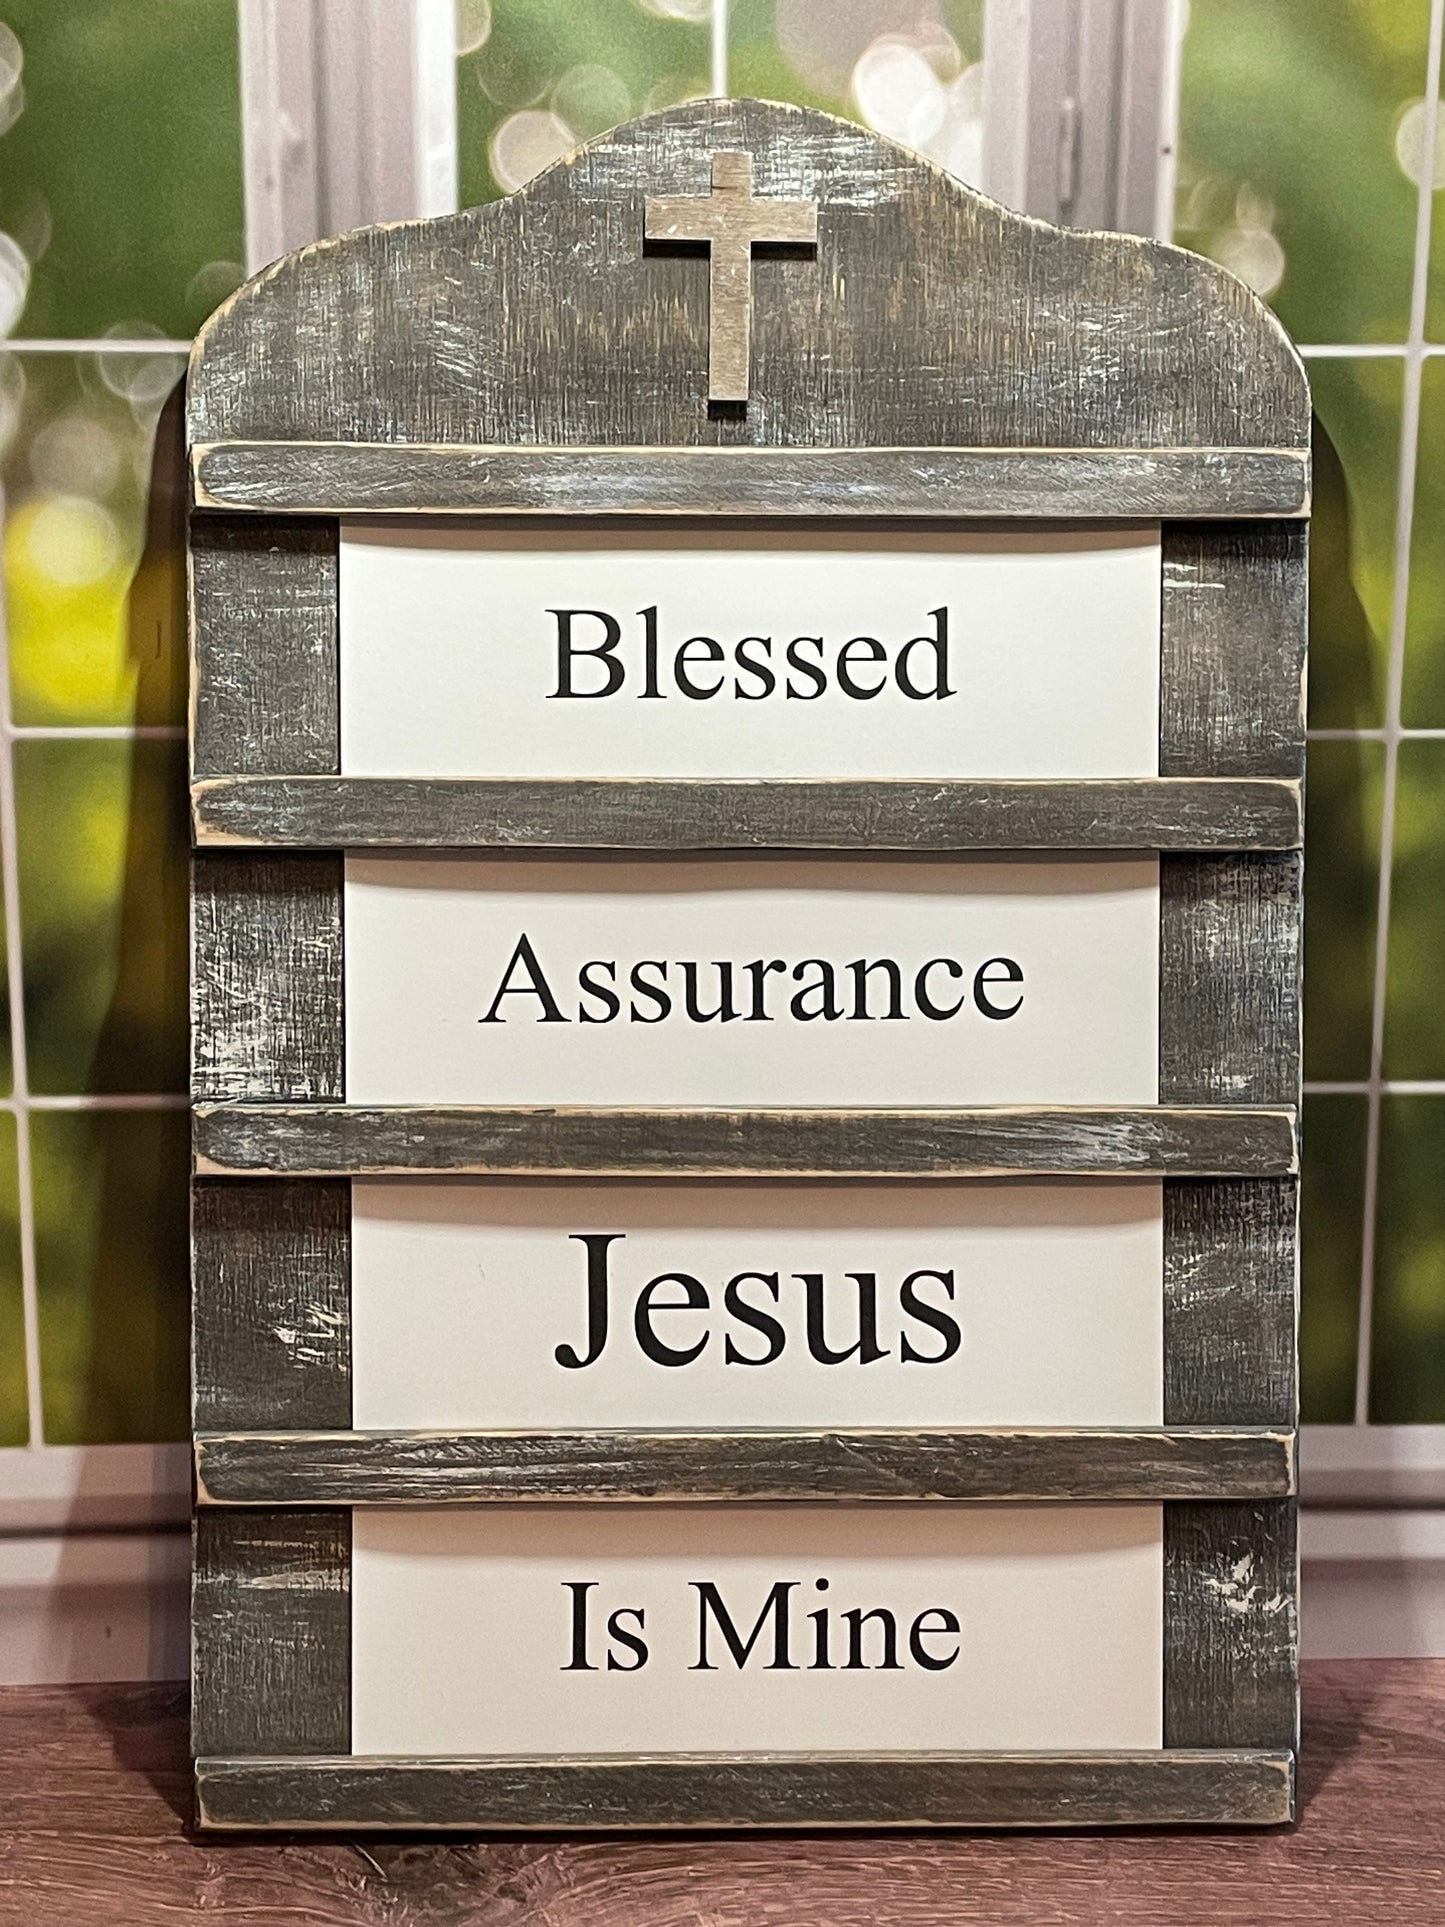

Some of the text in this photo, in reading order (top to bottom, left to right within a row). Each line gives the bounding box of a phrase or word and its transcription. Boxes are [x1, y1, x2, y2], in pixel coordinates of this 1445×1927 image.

[546, 606, 957, 700] Blessed
[478, 933, 1023, 1023] Assurance
[555, 1234, 961, 1368] Jesus
[560, 1578, 960, 1671] Is Mine
